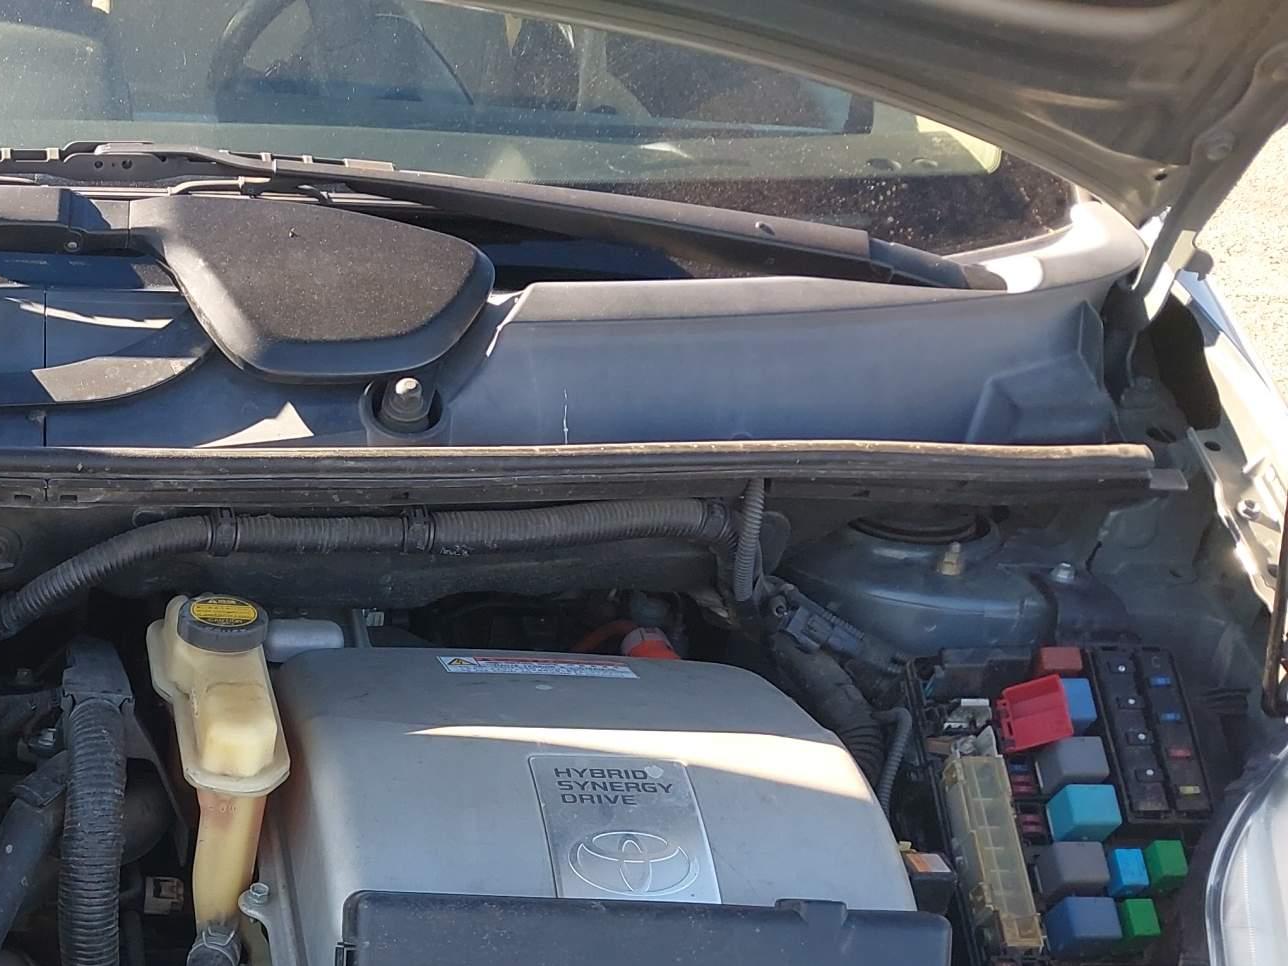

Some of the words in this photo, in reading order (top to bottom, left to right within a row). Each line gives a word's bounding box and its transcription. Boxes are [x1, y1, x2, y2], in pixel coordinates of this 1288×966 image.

[554, 767, 648, 780] HYBRID
[557, 780, 673, 794] SYNERGY
[561, 793, 638, 806] DRIVE
